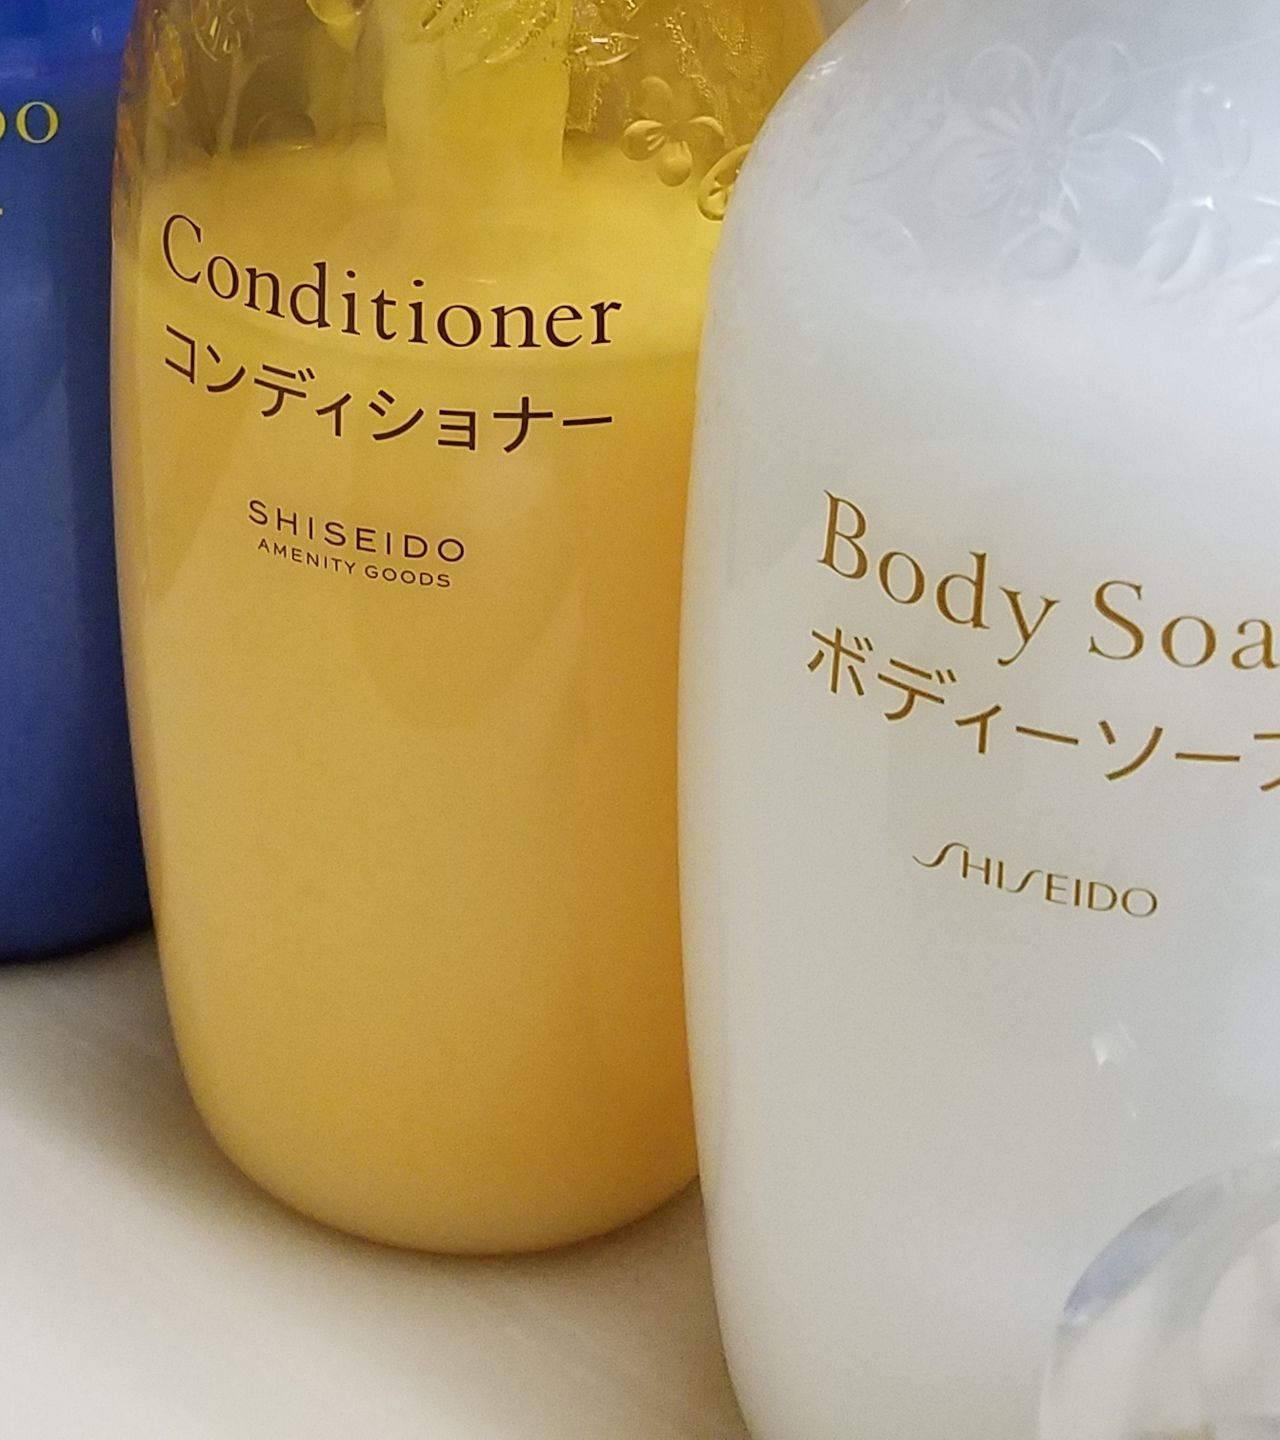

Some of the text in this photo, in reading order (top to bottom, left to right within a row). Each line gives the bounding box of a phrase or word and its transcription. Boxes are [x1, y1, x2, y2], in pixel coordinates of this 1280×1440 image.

[162, 214, 622, 349] Conditioner
[164, 323, 613, 454] コンディショナー
[247, 499, 465, 563] SHISEIDO
[257, 538, 451, 589] AMENITY GOODS
[817, 489, 1060, 666] Body
[912, 841, 1158, 917] SHISEIDO
